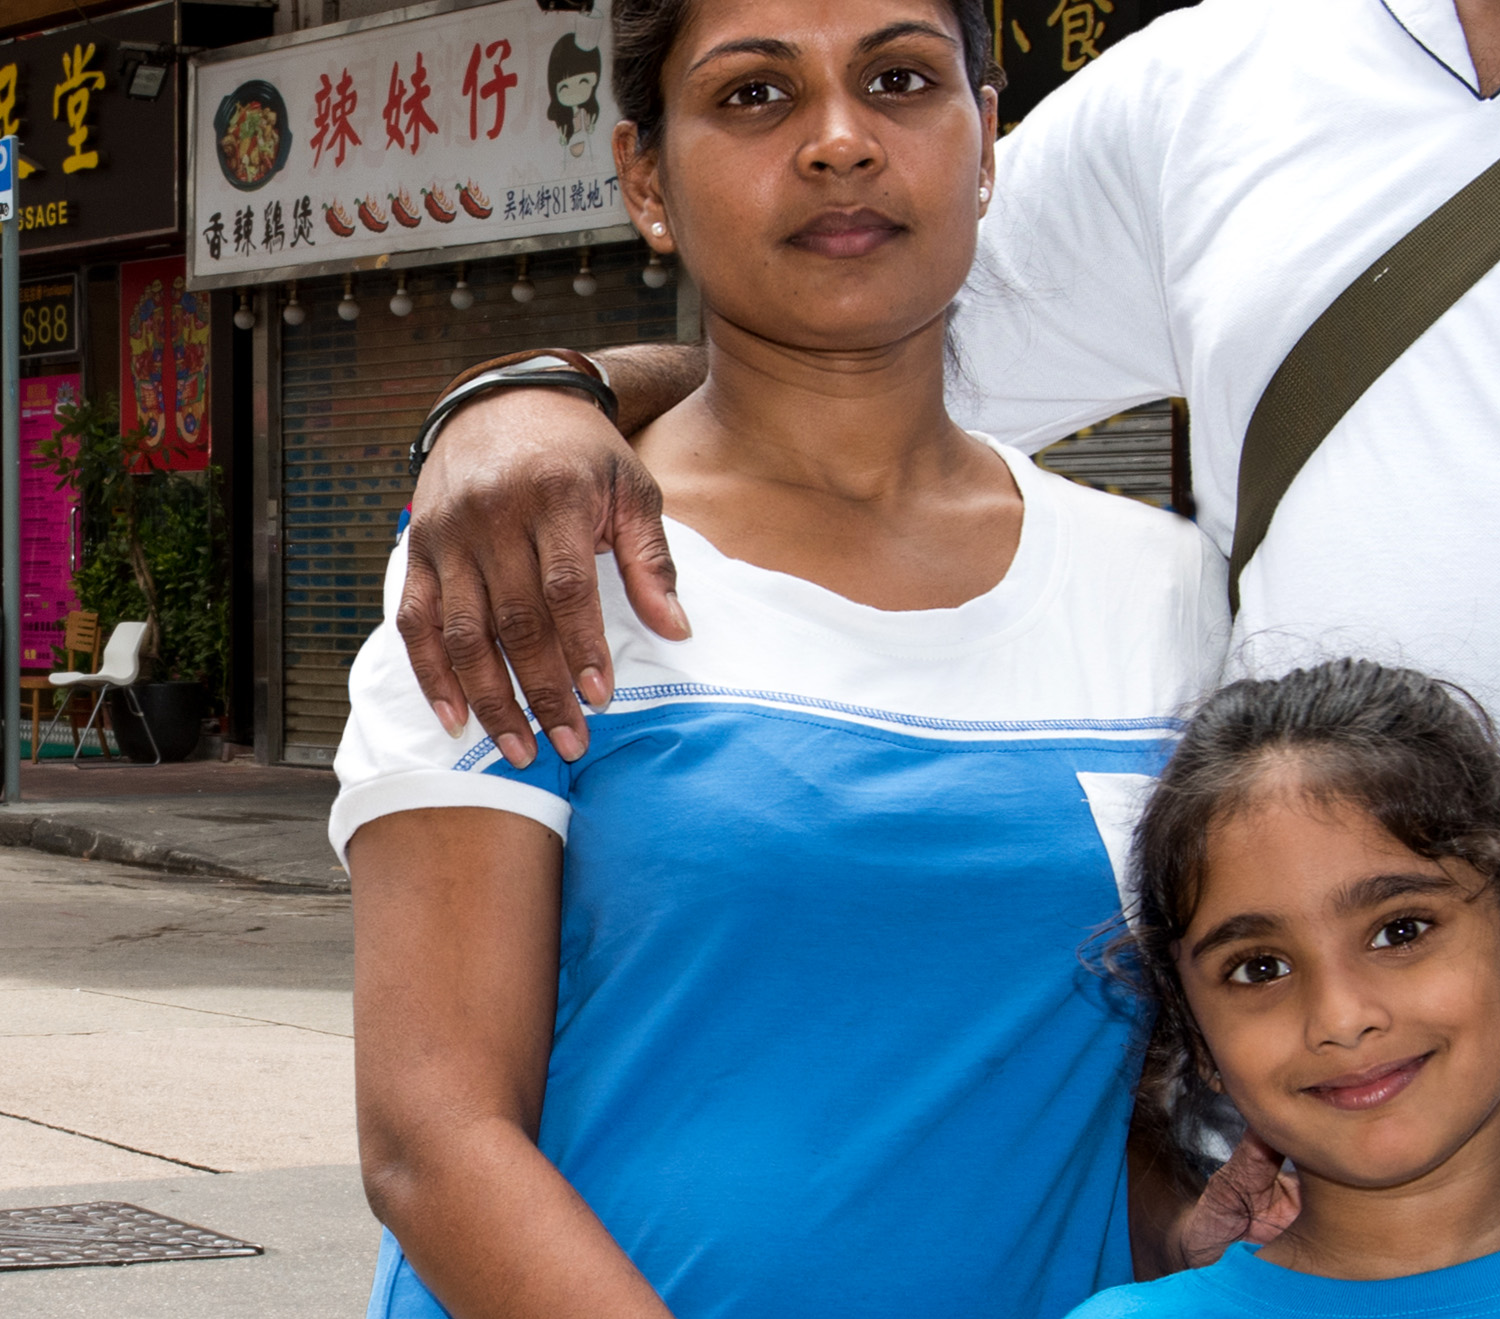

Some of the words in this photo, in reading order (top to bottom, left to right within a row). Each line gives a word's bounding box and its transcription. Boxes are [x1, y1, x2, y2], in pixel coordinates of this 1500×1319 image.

[310, 38, 518, 169] 辣妹仔
[22, 304, 68, 350] $88
